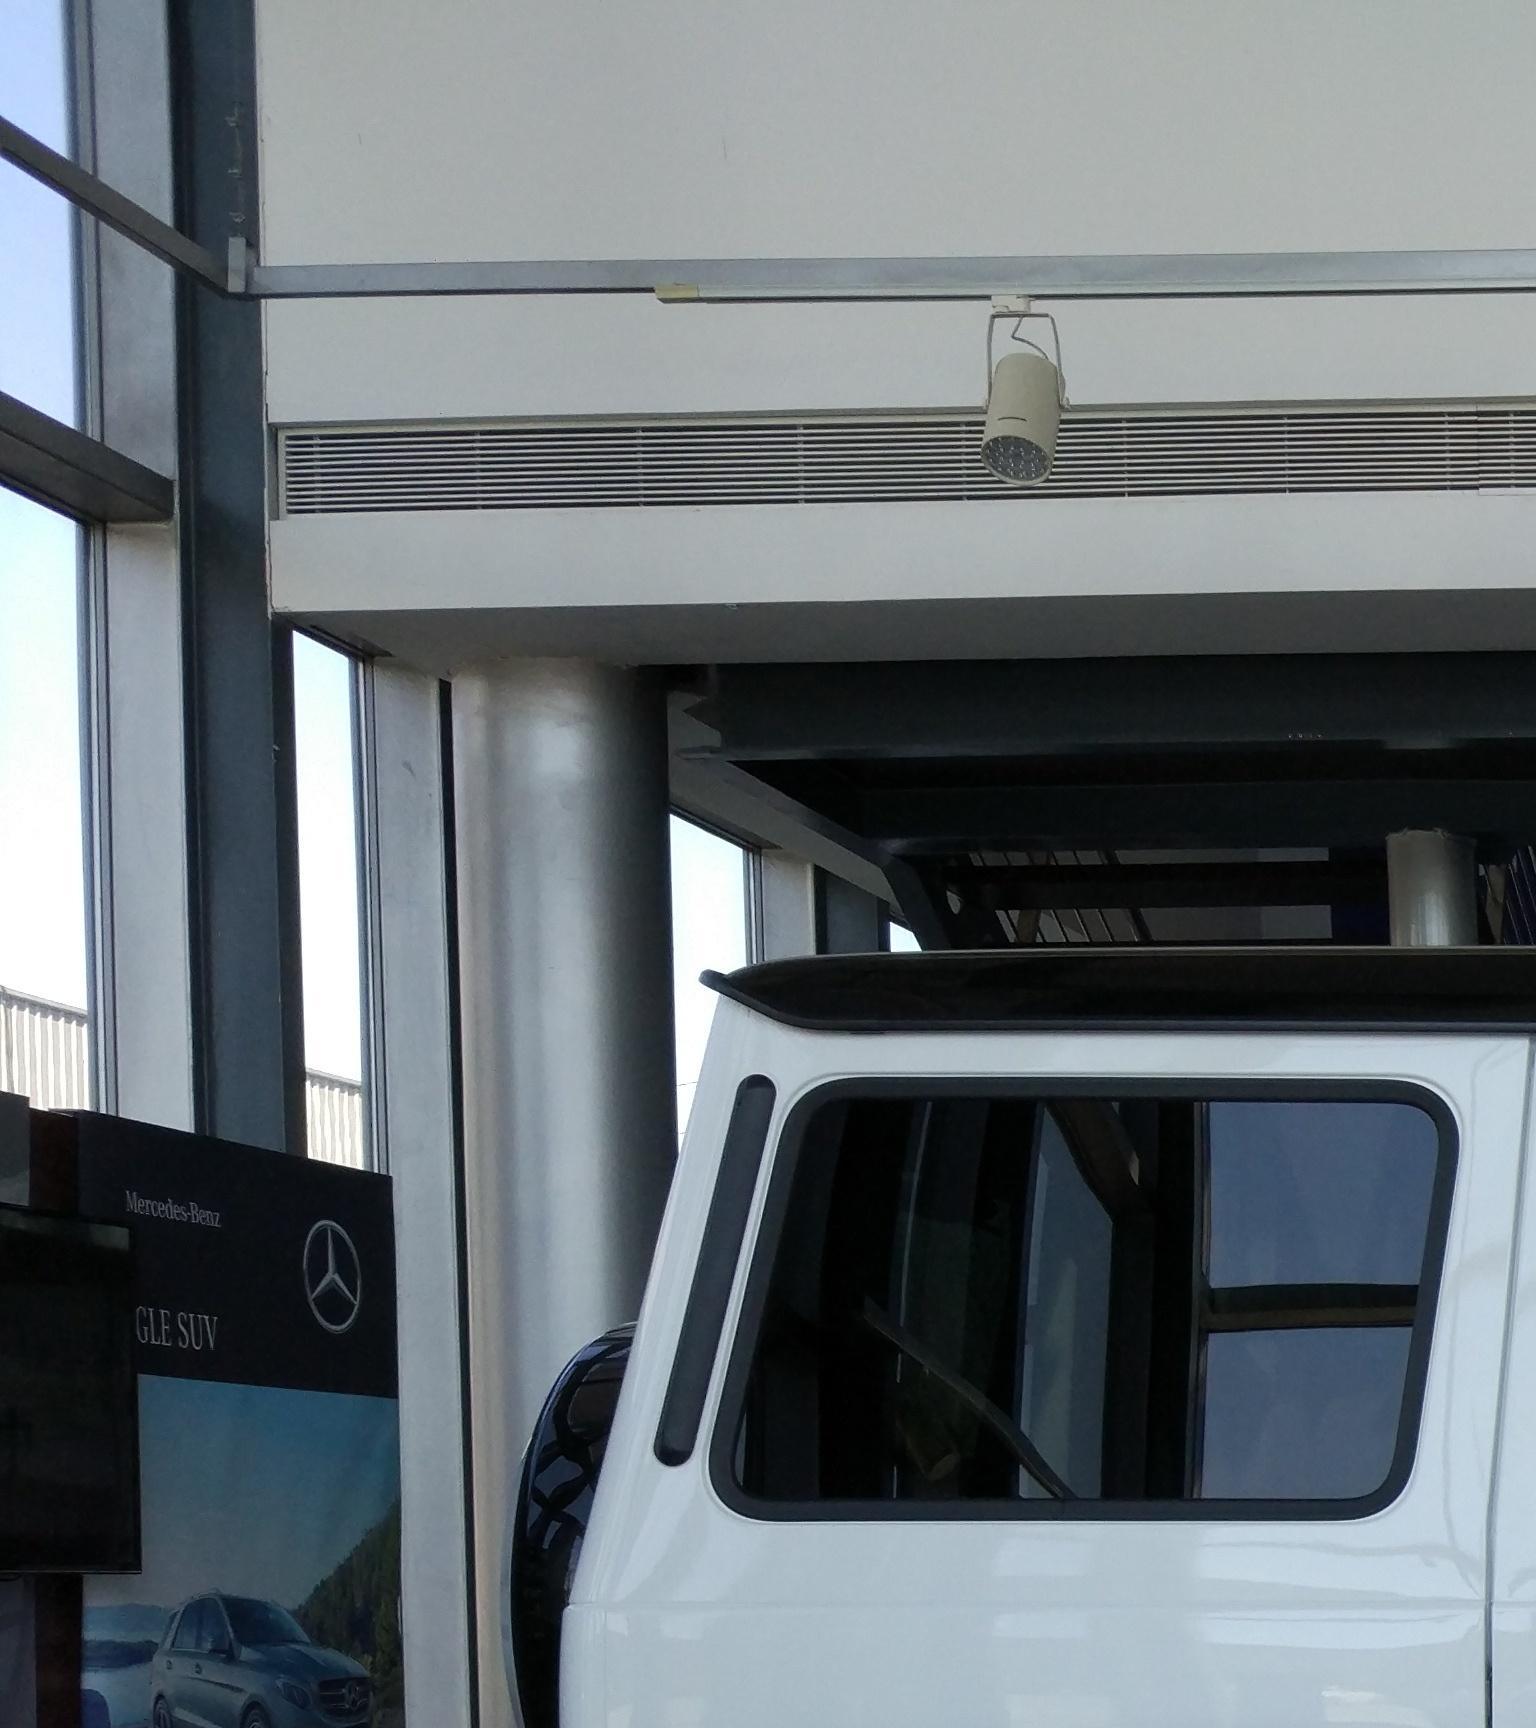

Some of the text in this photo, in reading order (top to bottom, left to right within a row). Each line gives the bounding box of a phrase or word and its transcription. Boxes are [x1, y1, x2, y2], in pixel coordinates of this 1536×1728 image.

[125, 1190, 222, 1228] Mercedes-Benz
[136, 1306, 218, 1351] GLE SUV
